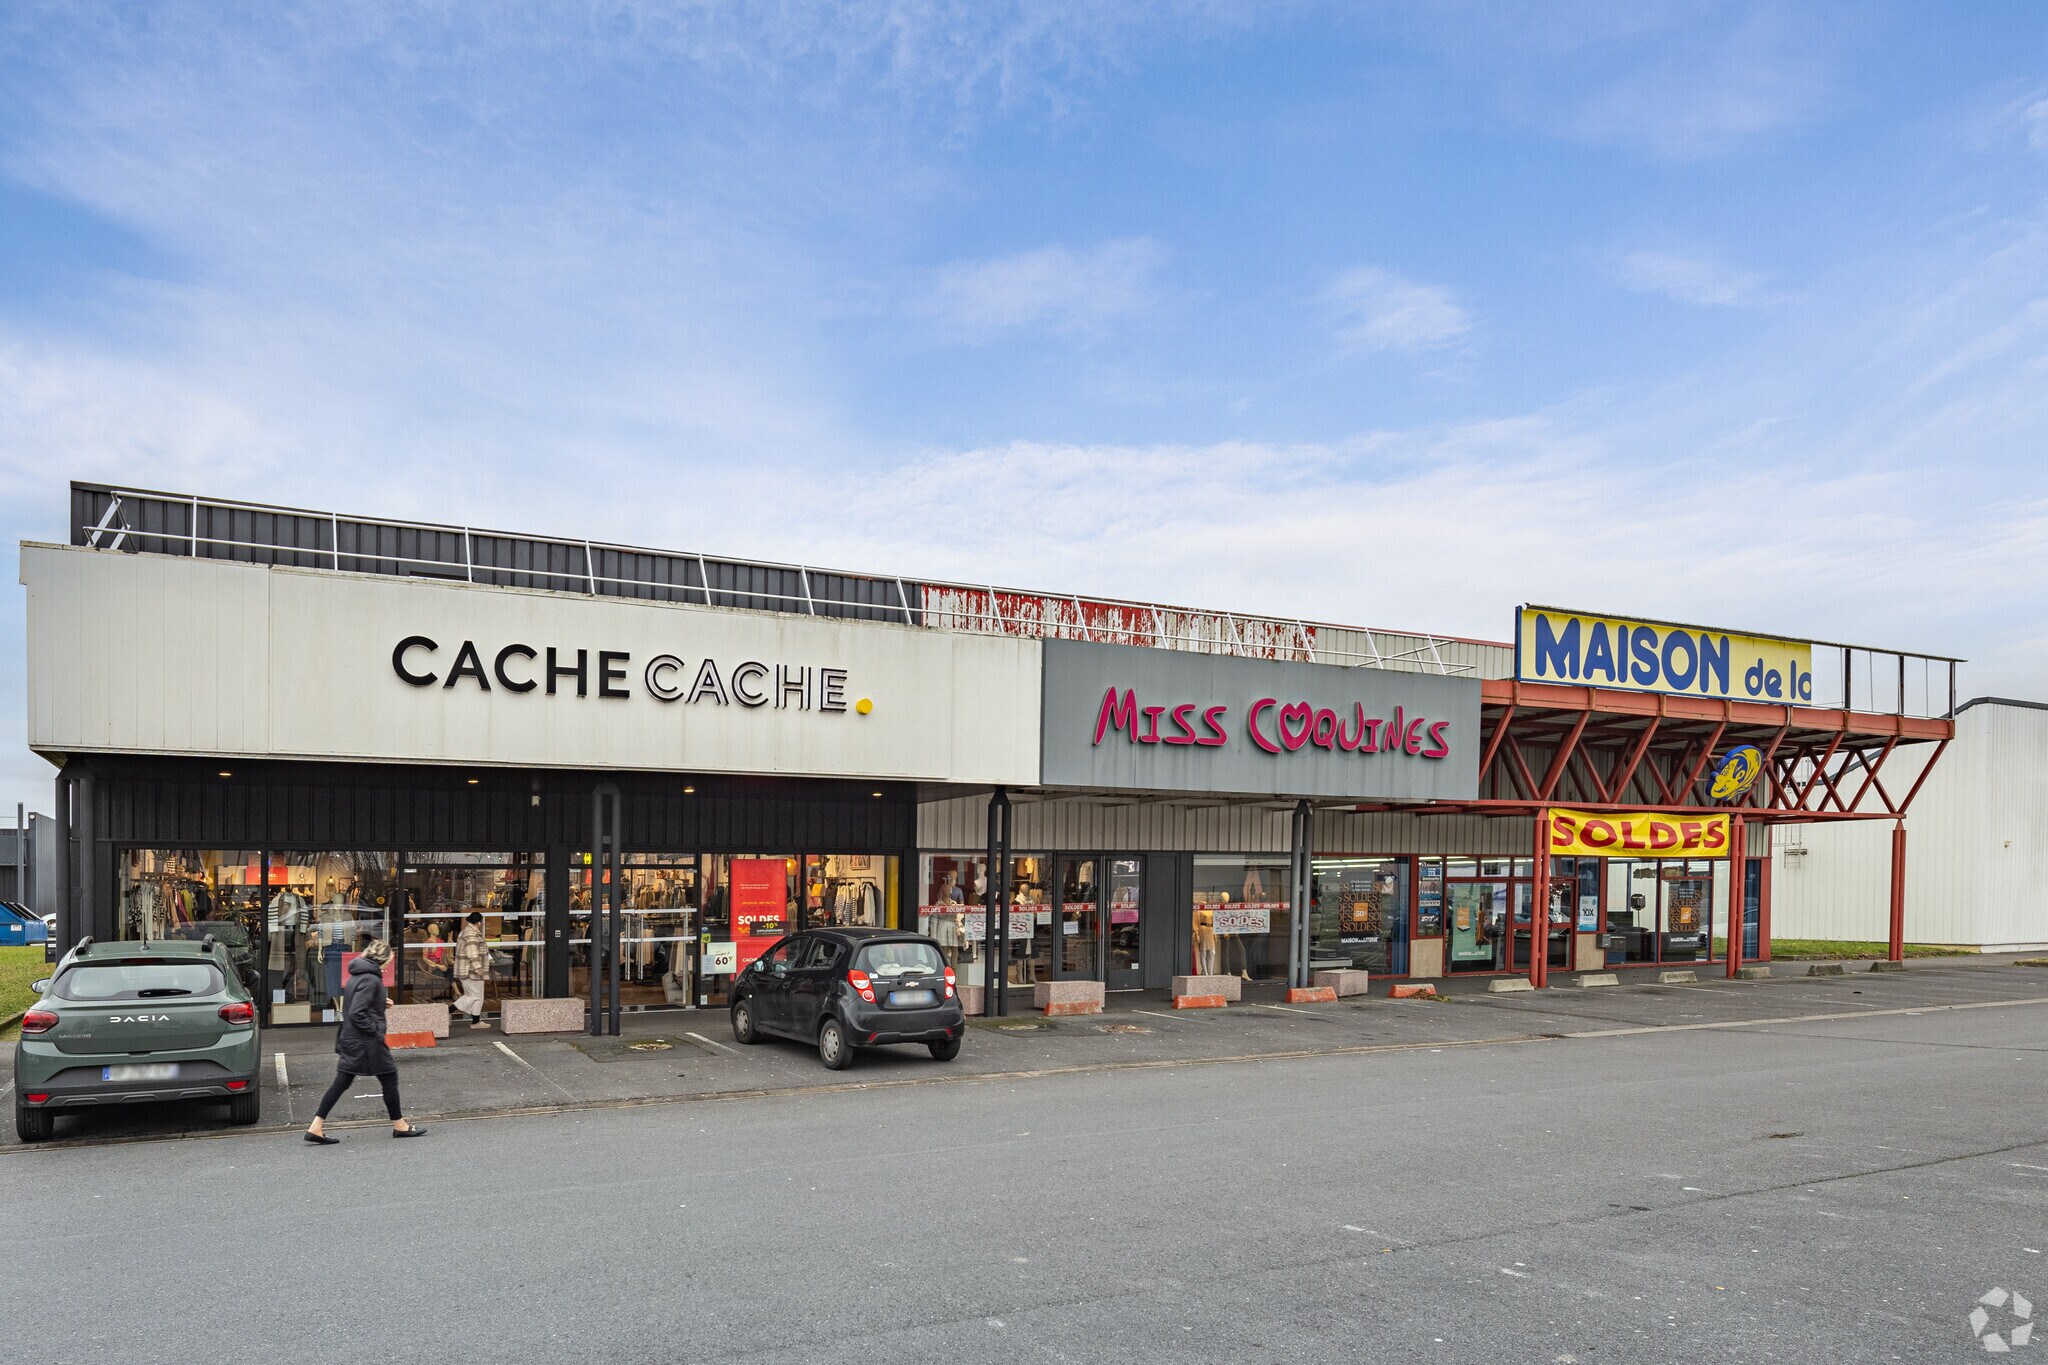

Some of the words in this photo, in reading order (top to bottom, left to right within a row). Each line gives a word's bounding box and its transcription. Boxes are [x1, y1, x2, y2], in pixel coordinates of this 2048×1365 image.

[391, 635, 631, 699] CACHE
[1535, 613, 1730, 696] MAISON
[1744, 658, 1783, 698] de
[1552, 815, 1727, 850] SOLDES
[1219, 915, 1265, 928] SOLDES
[110, 1014, 170, 1023] DACIA
